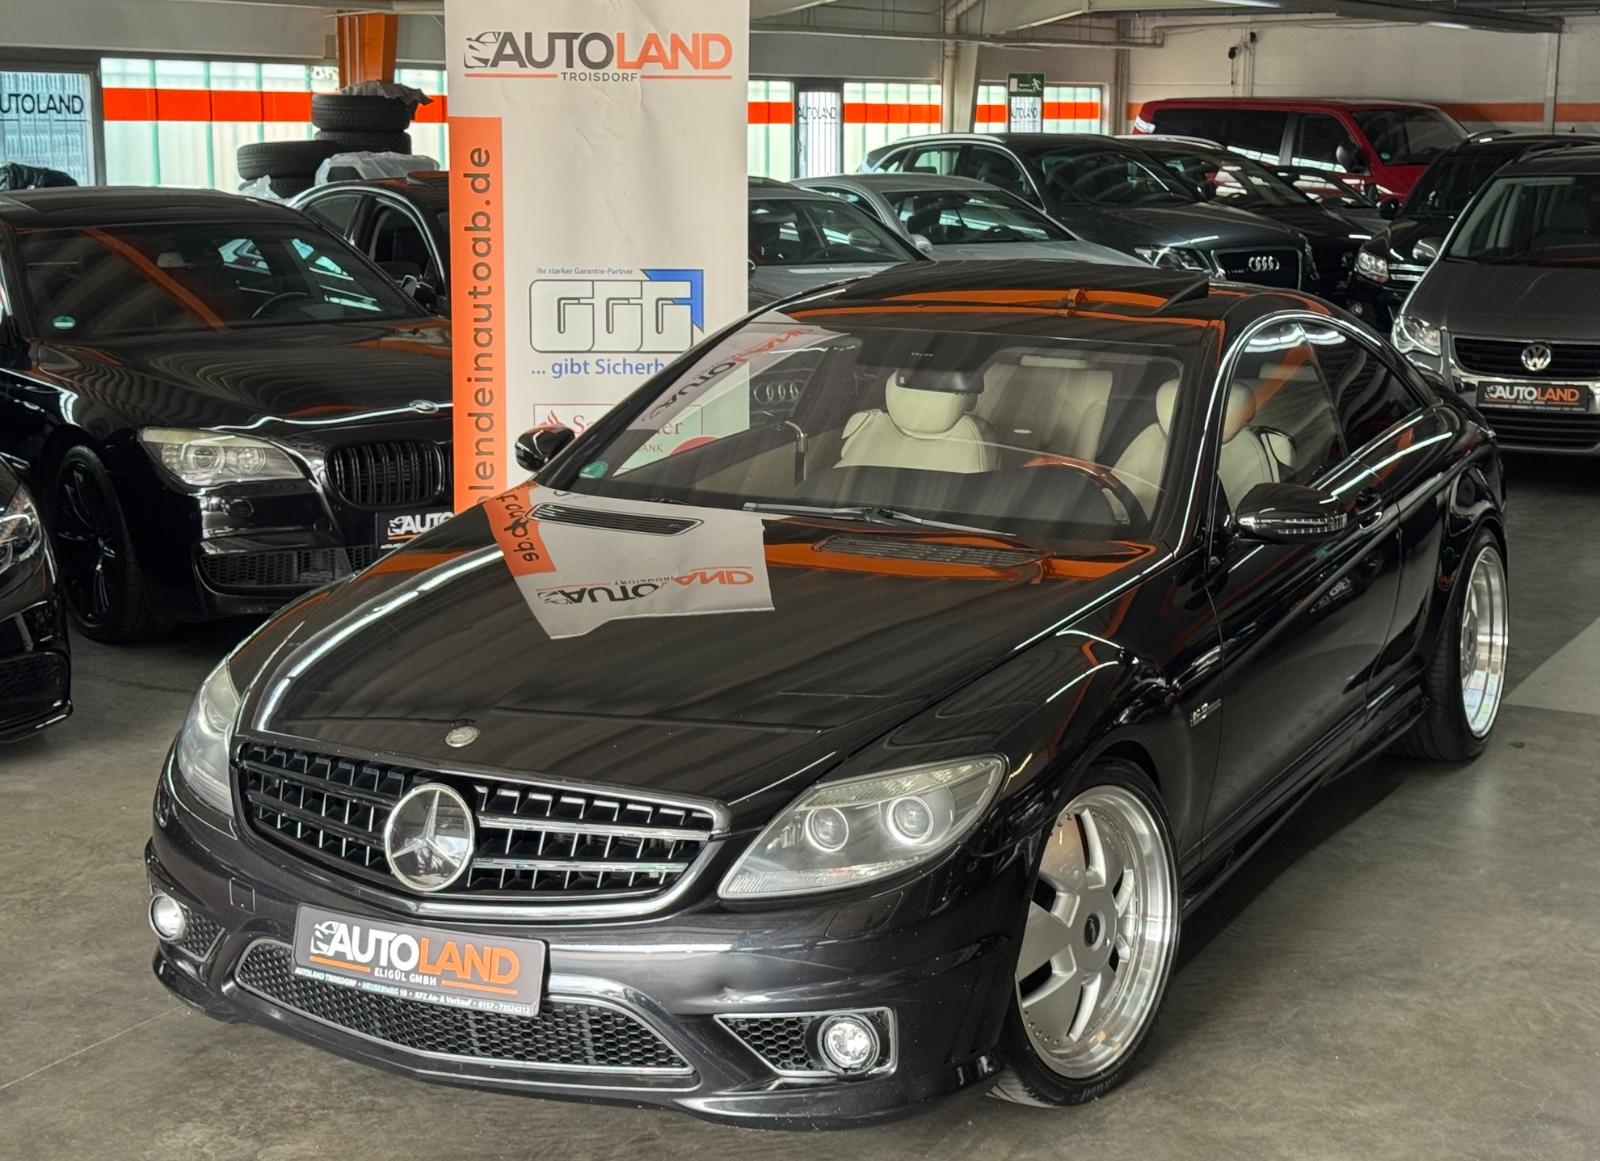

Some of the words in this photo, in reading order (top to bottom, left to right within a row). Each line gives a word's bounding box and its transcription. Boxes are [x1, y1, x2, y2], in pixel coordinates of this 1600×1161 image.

[490, 31, 733, 70] AUTOLAND
[560, 72, 638, 82] TROISDORF
[0, 93, 84, 114] UTOLAND
[536, 267, 547, 275] Ihr
[548, 267, 573, 275] starker
[574, 267, 633, 275] Garantie-Partner
[551, 358, 590, 379] gibt
[595, 358, 665, 375] Sicherh
[1495, 385, 1580, 401] AUTOLAND
[328, 922, 521, 985] AUTOLAND
[374, 967, 407, 981] ELIGÜL
[409, 973, 437, 987] GMBH
